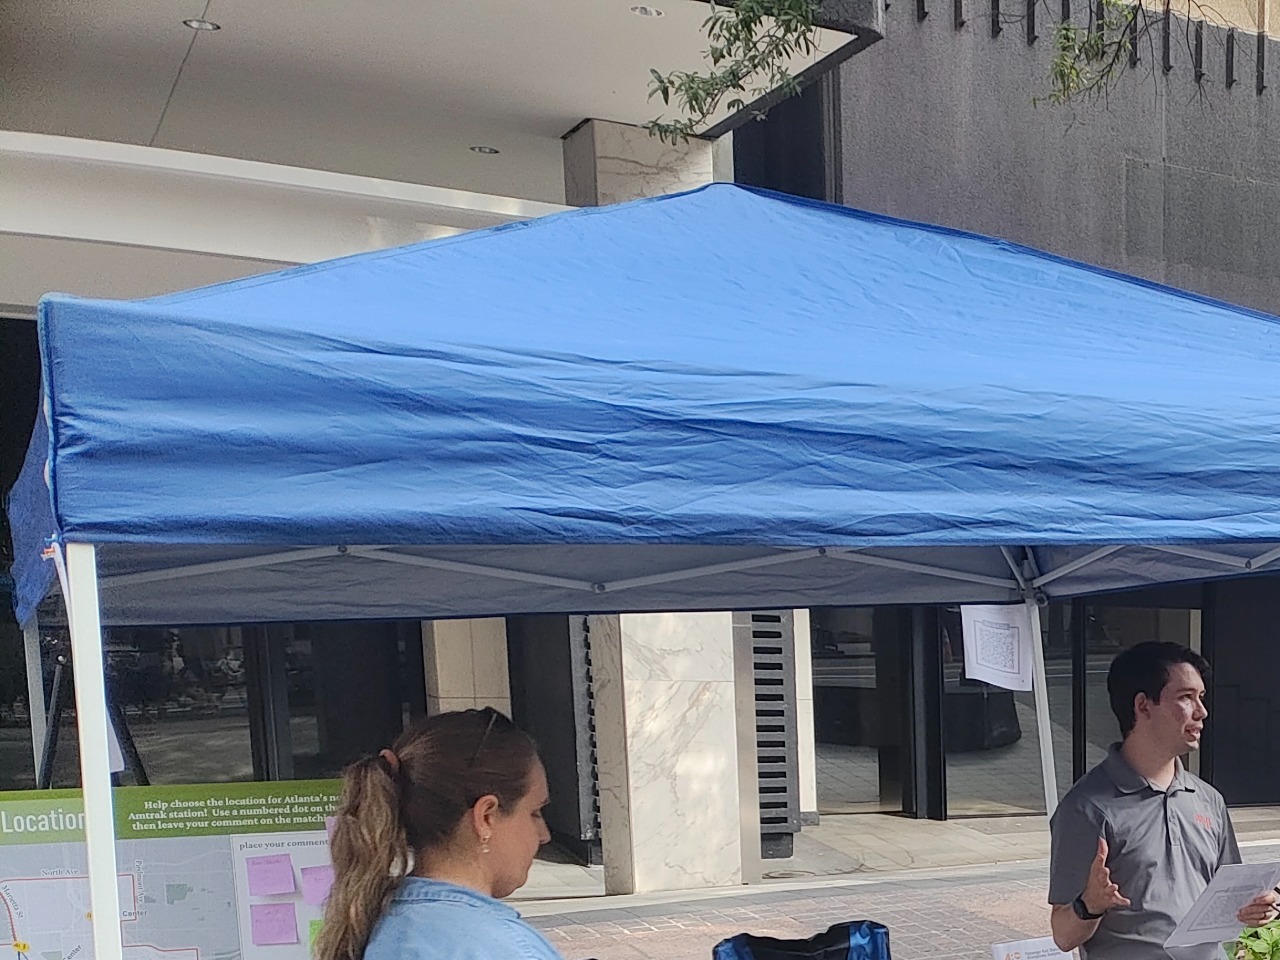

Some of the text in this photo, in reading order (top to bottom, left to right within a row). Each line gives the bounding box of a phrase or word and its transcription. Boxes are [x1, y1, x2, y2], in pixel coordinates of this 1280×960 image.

[144, 801, 168, 810] Help
[169, 799, 205, 808] choose
[207, 798, 223, 807] the
[225, 796, 266, 806] location
[267, 795, 282, 804] for
[284, 794, 328, 804] Atlanta's
[128, 811, 167, 820] Amtrak
[168, 809, 208, 819] station!
[212, 808, 230, 817] Use
[239, 806, 291, 816] numbered
[292, 805, 309, 813] dot
[310, 805, 323, 813] on
[324, 803, 336, 812] th
[132, 814, 327, 831] then leave your comment on the matchi
[239, 842, 263, 851] place
[264, 841, 285, 850] your
